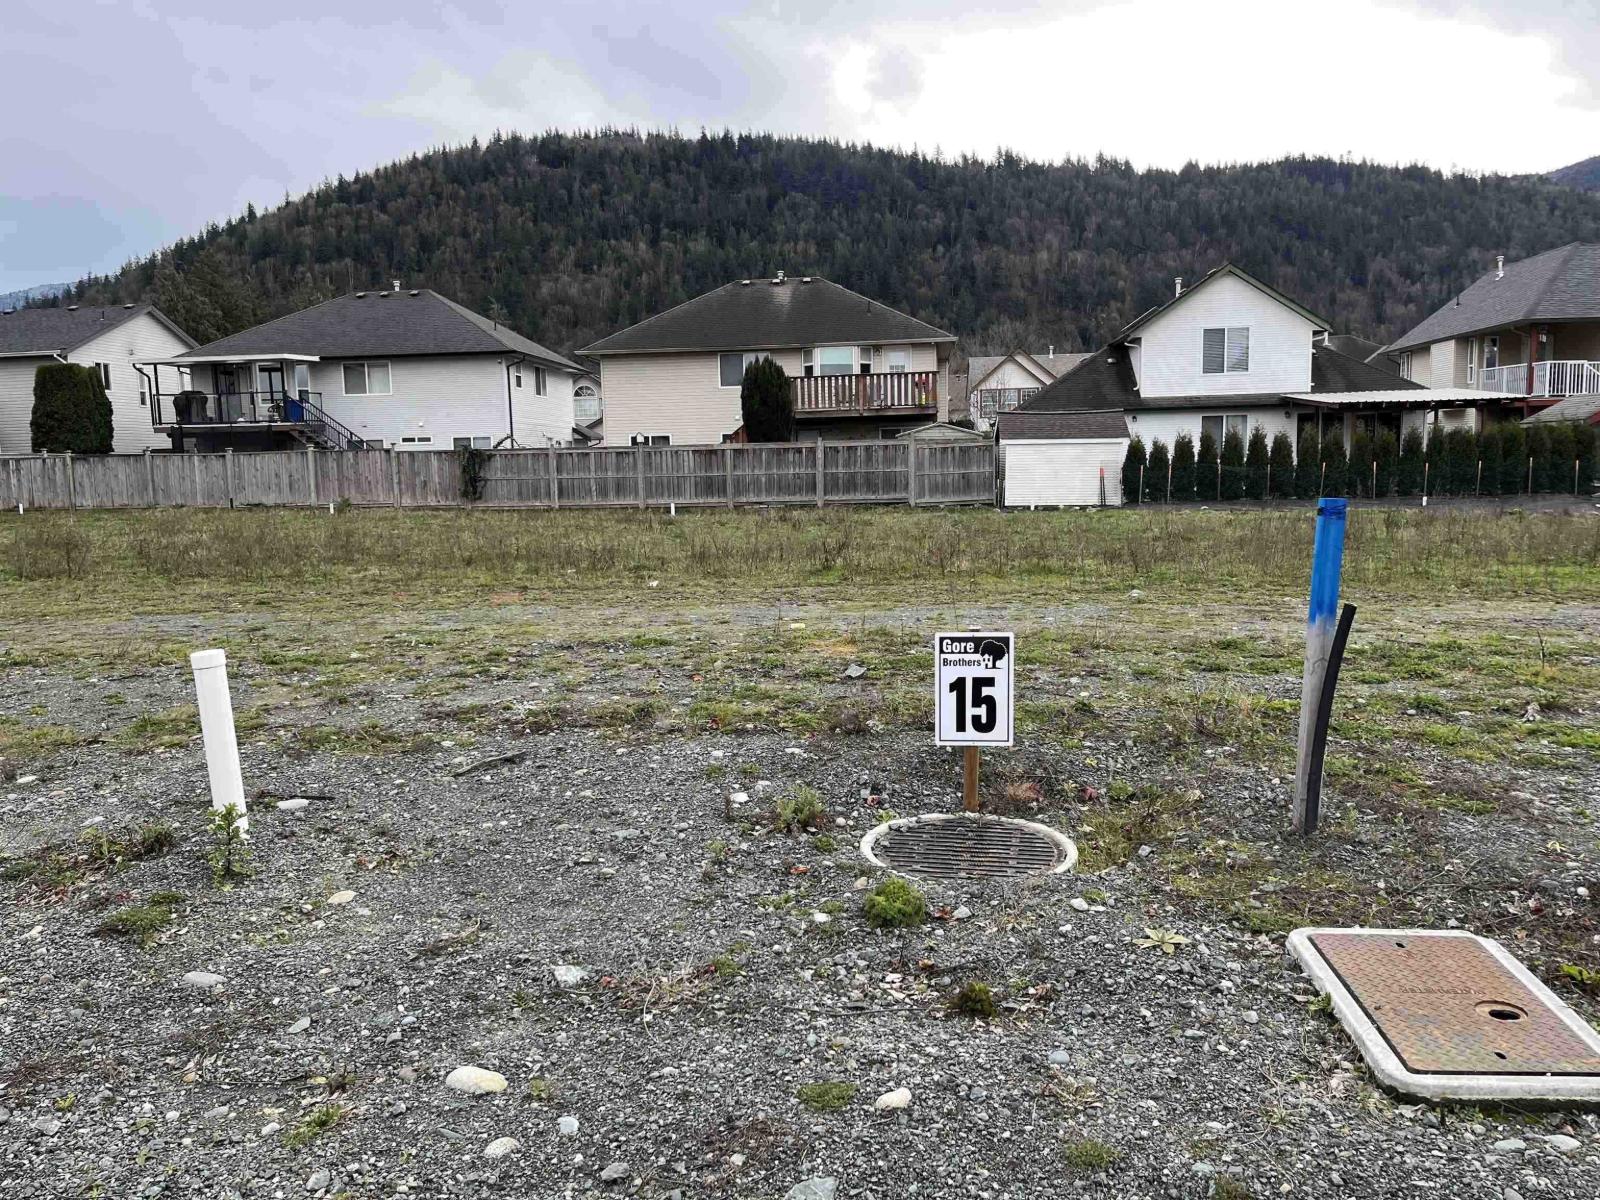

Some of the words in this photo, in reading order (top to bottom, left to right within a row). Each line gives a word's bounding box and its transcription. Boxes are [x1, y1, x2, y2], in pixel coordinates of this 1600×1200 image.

[942, 639, 975, 653] Gore
[942, 657, 982, 667] Brothers
[949, 676, 997, 734] 15
